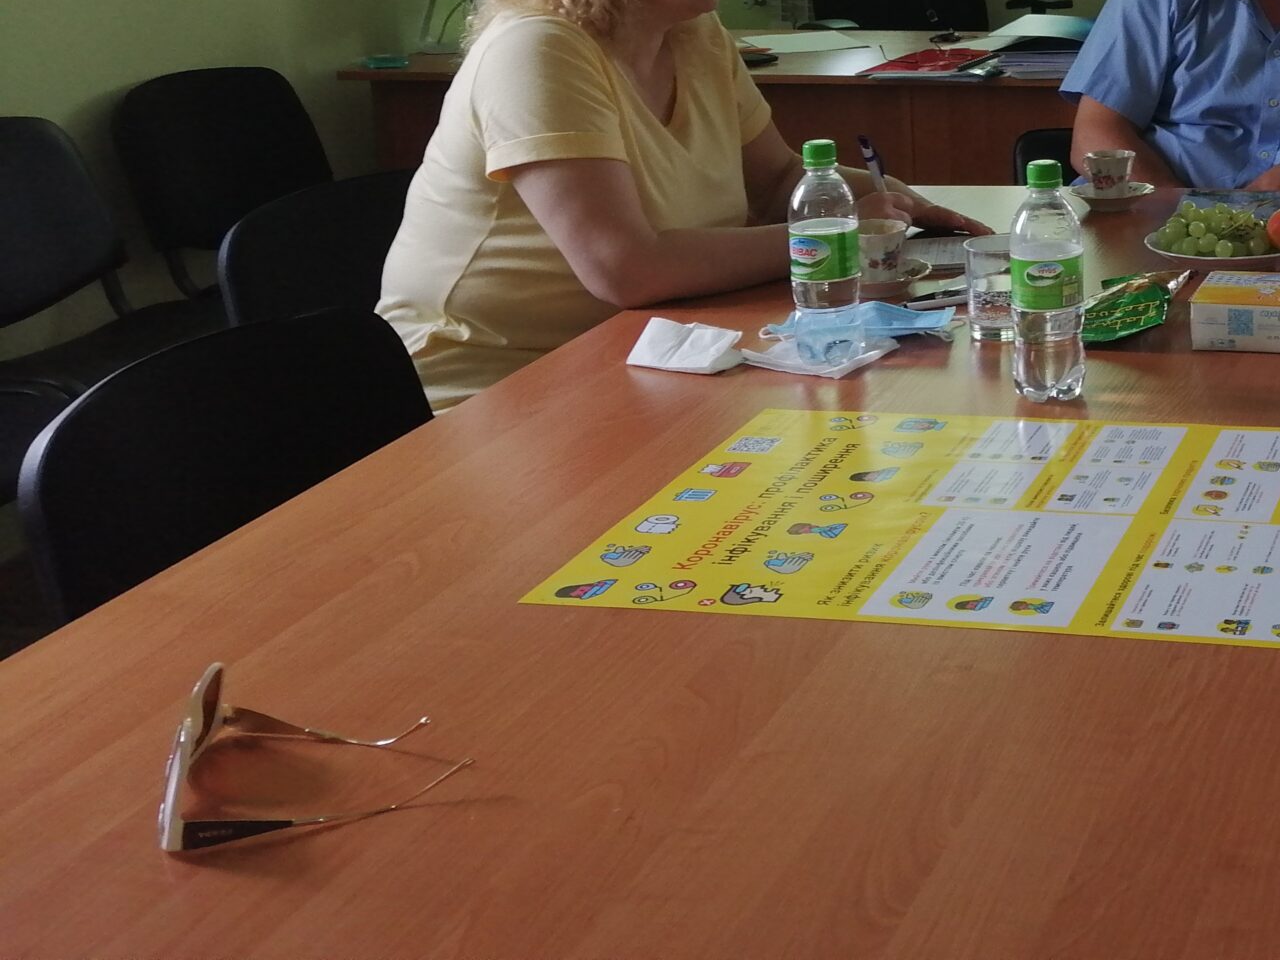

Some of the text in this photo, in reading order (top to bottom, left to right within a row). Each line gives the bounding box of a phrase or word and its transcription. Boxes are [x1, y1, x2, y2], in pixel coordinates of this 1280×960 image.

[671, 500, 766, 570] Коронавірус:
[757, 437, 838, 498] профілактика
[711, 501, 797, 565] інфікування
[793, 443, 860, 493] поширення
